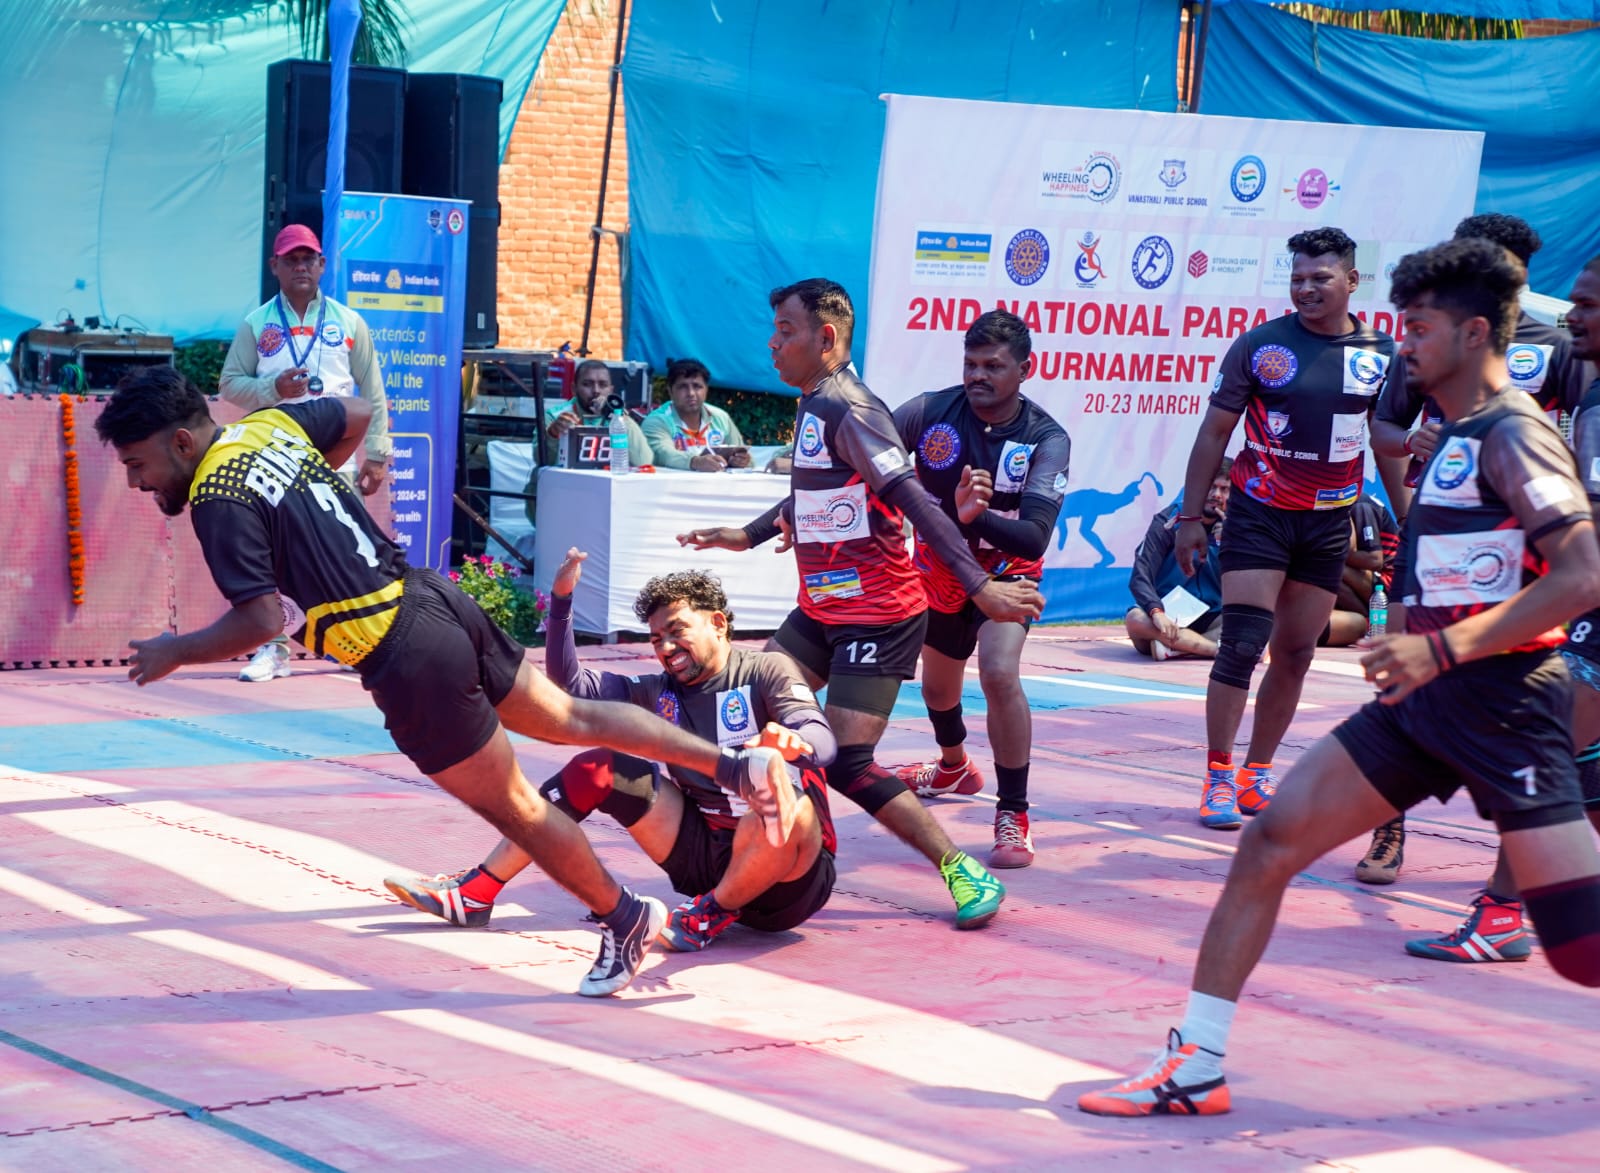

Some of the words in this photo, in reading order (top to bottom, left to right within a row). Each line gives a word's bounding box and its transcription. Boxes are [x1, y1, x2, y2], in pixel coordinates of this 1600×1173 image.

[1042, 171, 1089, 184] WHEELING
[1049, 183, 1088, 193] HAPPINESS
[1164, 196, 1184, 206] PUBLIC
[1186, 197, 1208, 207] SCHOOL
[906, 297, 981, 331] 2ND
[369, 326, 416, 343] extends
[418, 331, 426, 343] a
[391, 349, 447, 367] Welcome
[1024, 351, 1216, 383] OURNAMENT
[386, 372, 401, 388] All
[404, 373, 423, 388] the
[1084, 393, 1131, 414] 20-23
[1137, 394, 1201, 415] MARCH
[392, 447, 412, 459] ional
[1270, 446, 1292, 458] PUBLIC
[1293, 451, 1320, 461] SCHOOL
[389, 468, 414, 480] baddi
[309, 482, 379, 568] 7
[405, 511, 422, 522] with
[1570, 620, 1593, 644] 8
[846, 641, 878, 664] 12
[1511, 764, 1538, 797] 7
